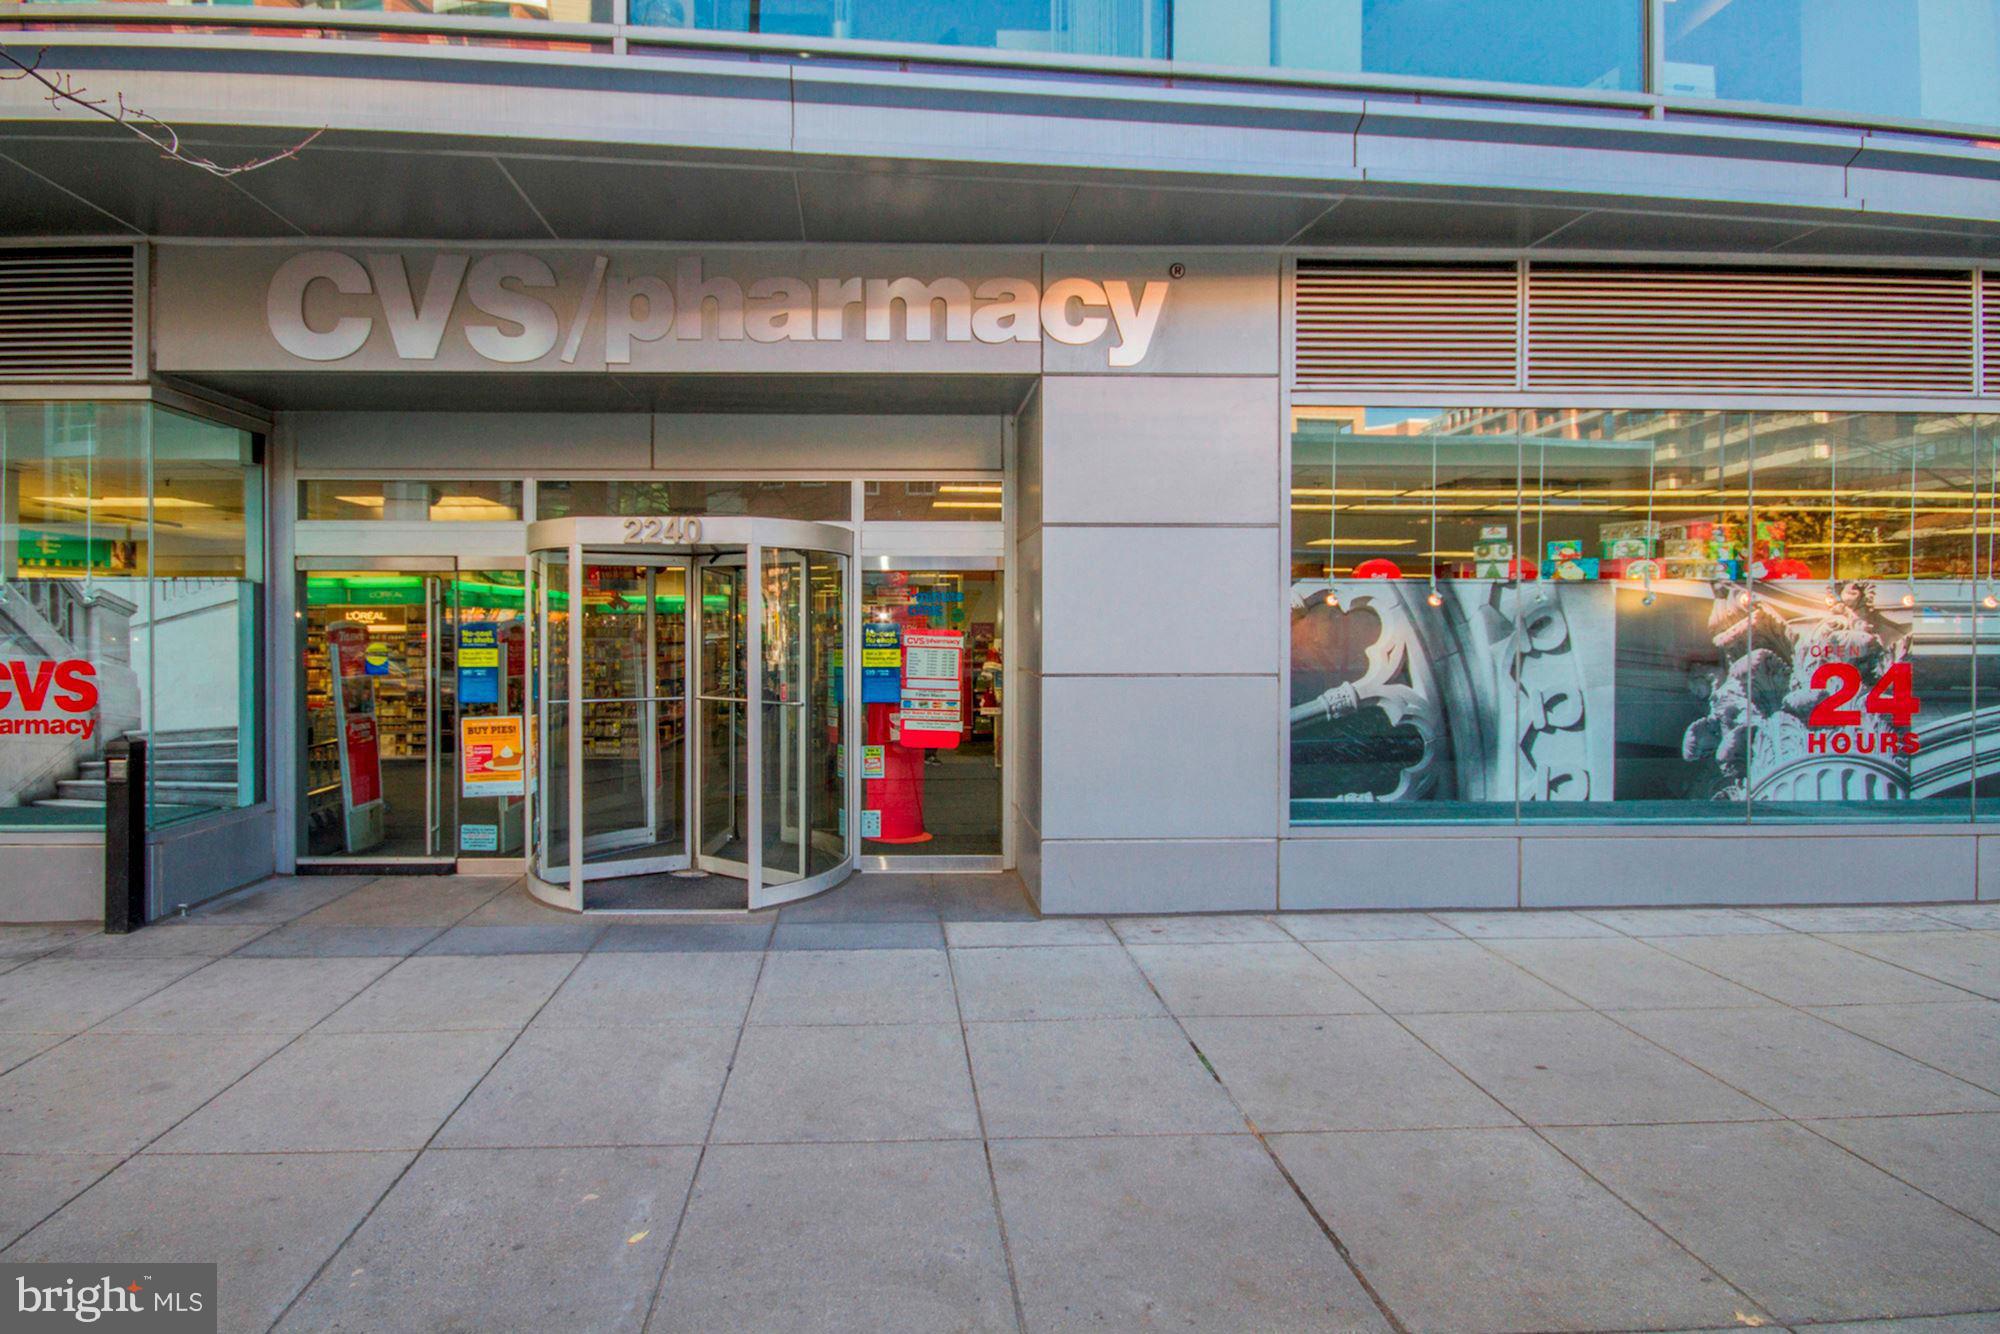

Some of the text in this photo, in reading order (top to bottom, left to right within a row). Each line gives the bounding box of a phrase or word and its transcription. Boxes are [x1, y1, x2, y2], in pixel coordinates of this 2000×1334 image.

[623, 516, 703, 545] 2240
[1810, 645, 1860, 657] OPEN
[0, 659, 98, 713] VS
[1808, 662, 1921, 728] 24
[467, 725, 517, 735] BUY PIES!
[1808, 732, 1921, 755] HOURS
